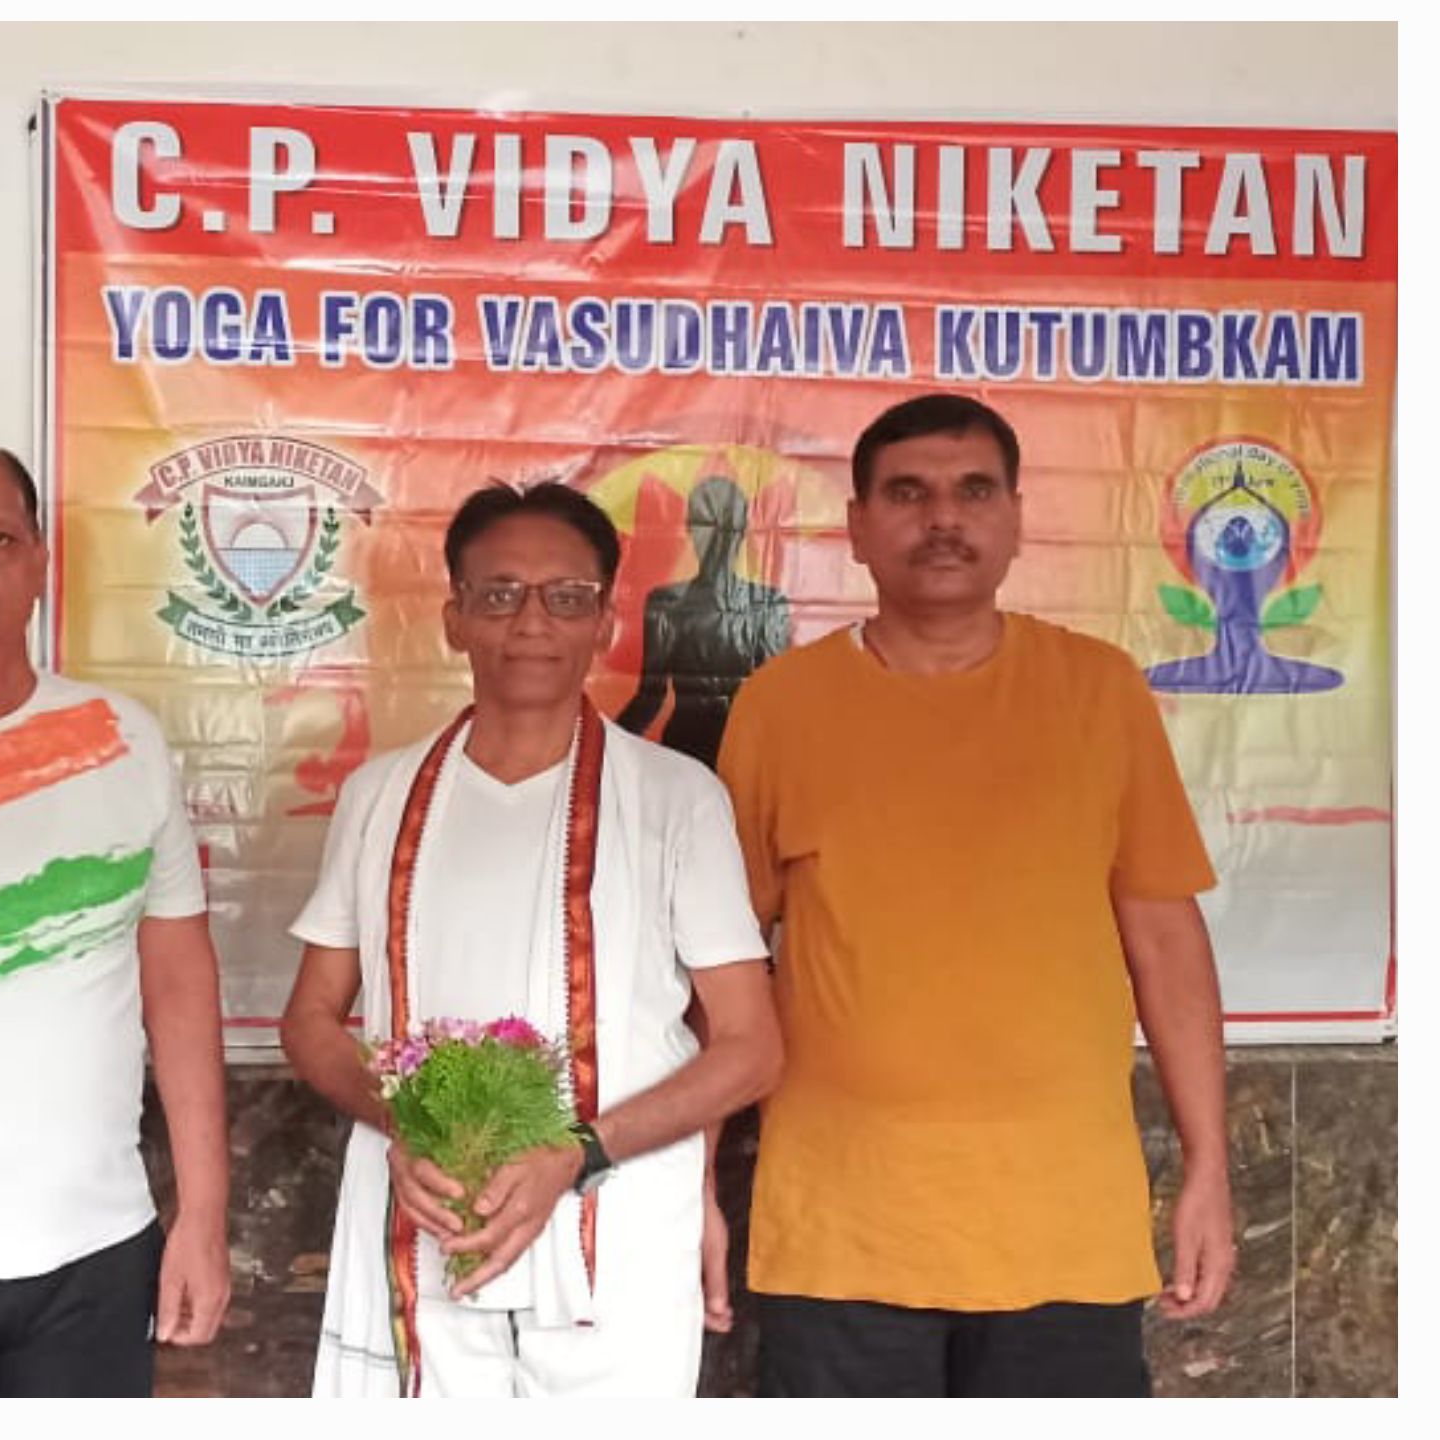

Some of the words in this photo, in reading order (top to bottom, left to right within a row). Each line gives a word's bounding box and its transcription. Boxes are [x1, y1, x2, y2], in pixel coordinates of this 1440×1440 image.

[111, 121, 334, 235] C.P.
[407, 131, 774, 245] VIDYA
[842, 141, 1367, 258] NIKETAN
[105, 287, 295, 364] YOGA
[322, 294, 452, 367] FOR
[481, 297, 908, 377] VASUDHAIVA
[937, 308, 1361, 383] KUTUMBKAM
[198, 441, 265, 471] VIDYA
[271, 441, 362, 491] NIKETAN
